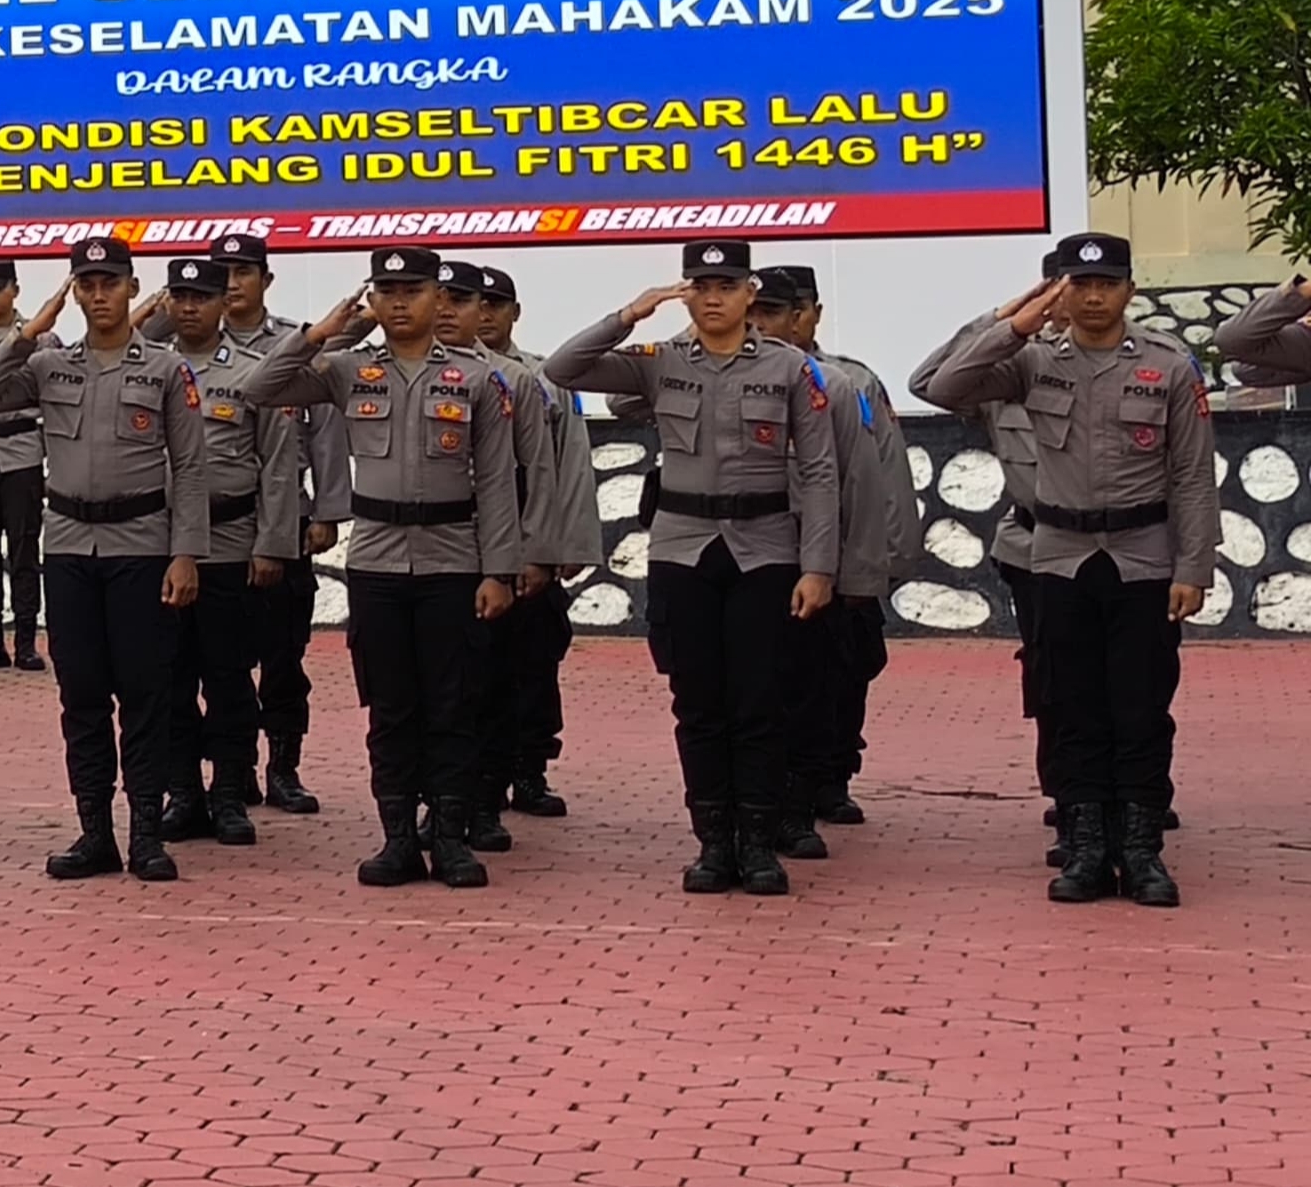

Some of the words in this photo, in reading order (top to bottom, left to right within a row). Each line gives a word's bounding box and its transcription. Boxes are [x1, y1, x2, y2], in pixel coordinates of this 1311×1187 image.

[230, 100, 746, 143] KAMSELTIBCAR
[770, 93, 946, 125] LALU
[343, 152, 494, 180] IDUL
[517, 143, 688, 174] FITRI
[719, 139, 877, 168] 1446
[307, 207, 580, 238] TRANSPARANSI
[579, 202, 837, 231] BERKEADILAN
[124, 374, 164, 388] POLRI
[429, 385, 470, 399] POLRI
[742, 384, 787, 397] POLRI
[1122, 384, 1169, 399] POLRI
